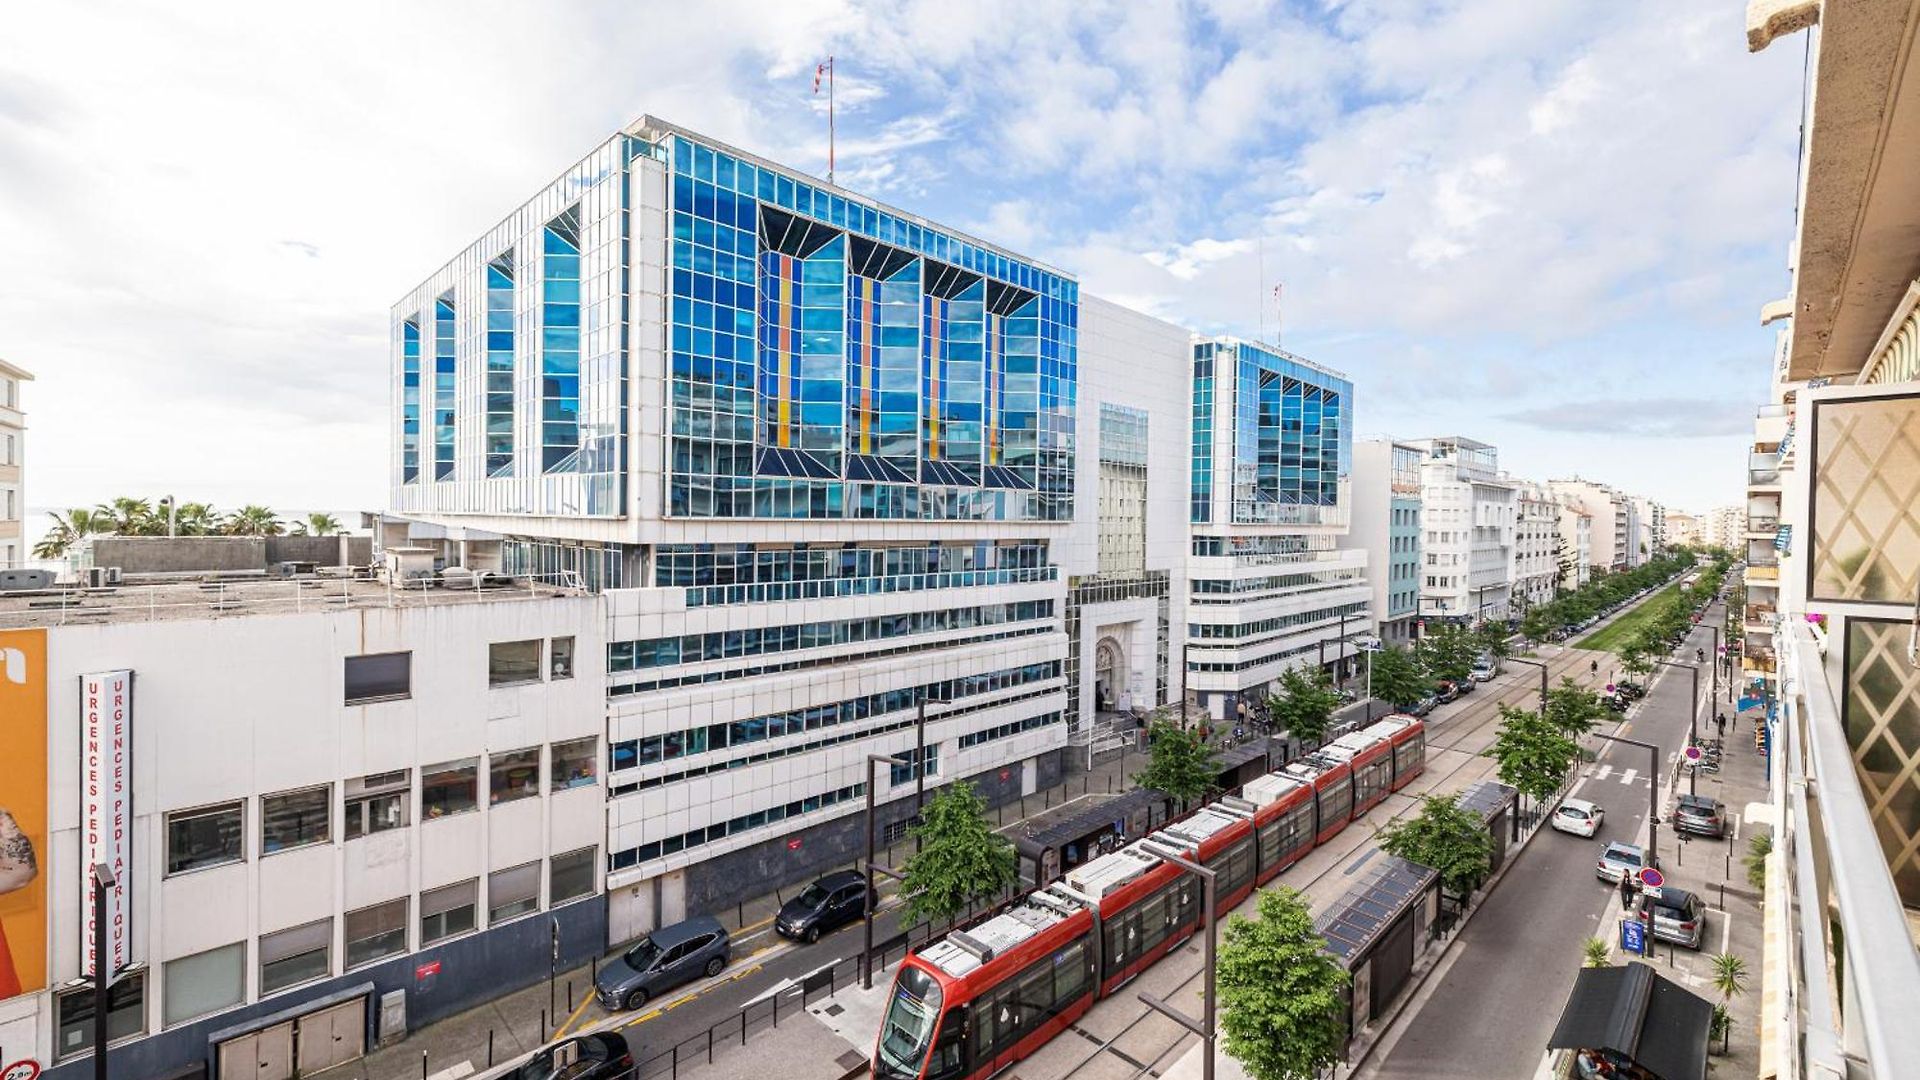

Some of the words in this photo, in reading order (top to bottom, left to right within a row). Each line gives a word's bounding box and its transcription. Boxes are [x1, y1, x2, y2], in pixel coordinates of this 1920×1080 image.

[89, 683, 97, 796] URGENCES
[114, 680, 122, 792] URGENCES
[114, 800, 122, 969] PEDIATRIQUES
